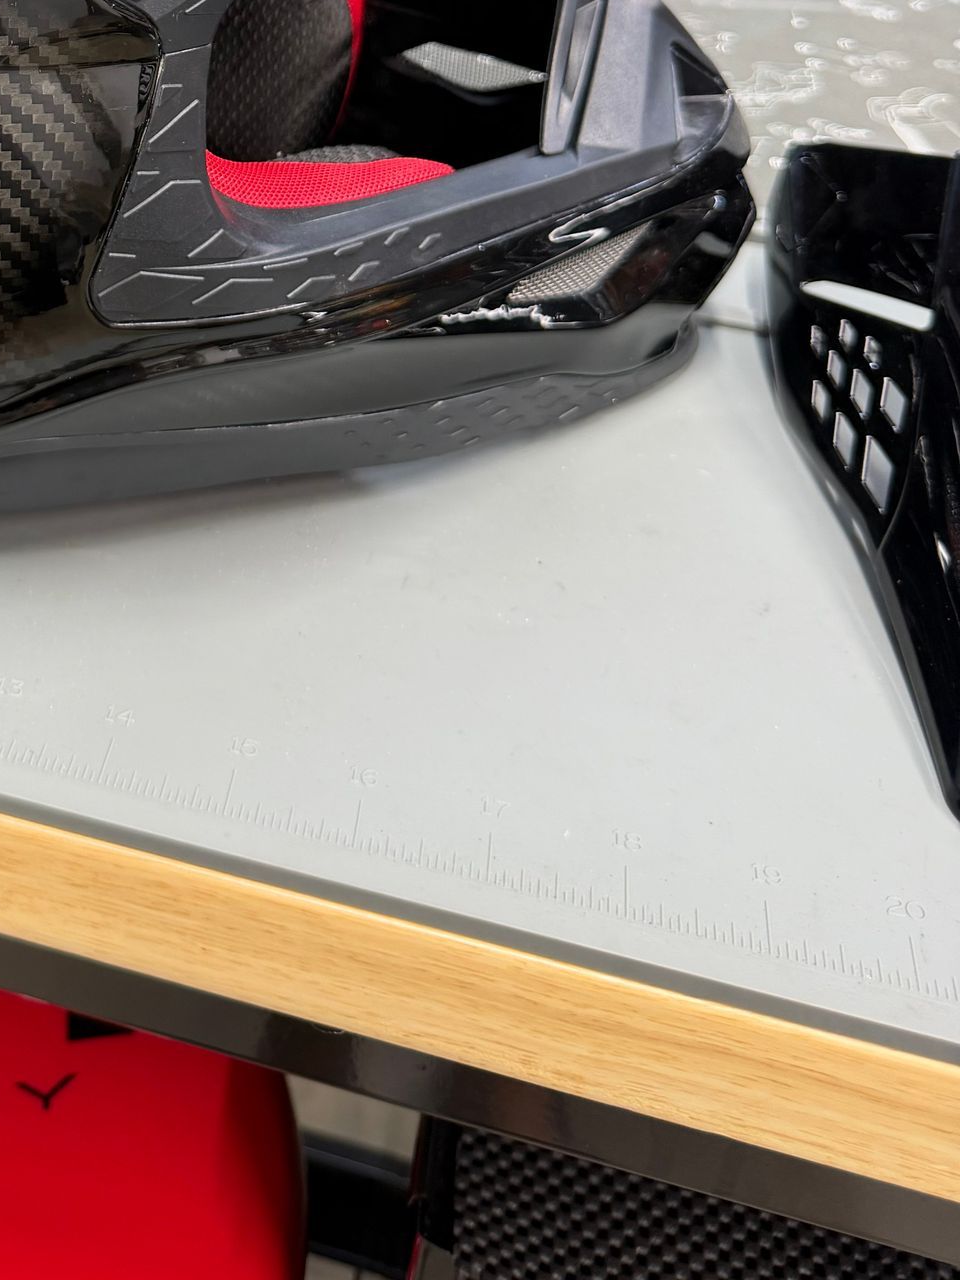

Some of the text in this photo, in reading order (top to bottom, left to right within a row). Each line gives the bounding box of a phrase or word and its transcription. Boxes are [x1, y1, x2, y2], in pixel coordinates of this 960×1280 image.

[104, 704, 136, 728] 14
[228, 735, 259, 758] 15
[348, 763, 378, 787] 16
[480, 793, 511, 819] 17
[611, 827, 642, 851] 18
[750, 861, 783, 886] 19
[885, 894, 927, 921] 20
